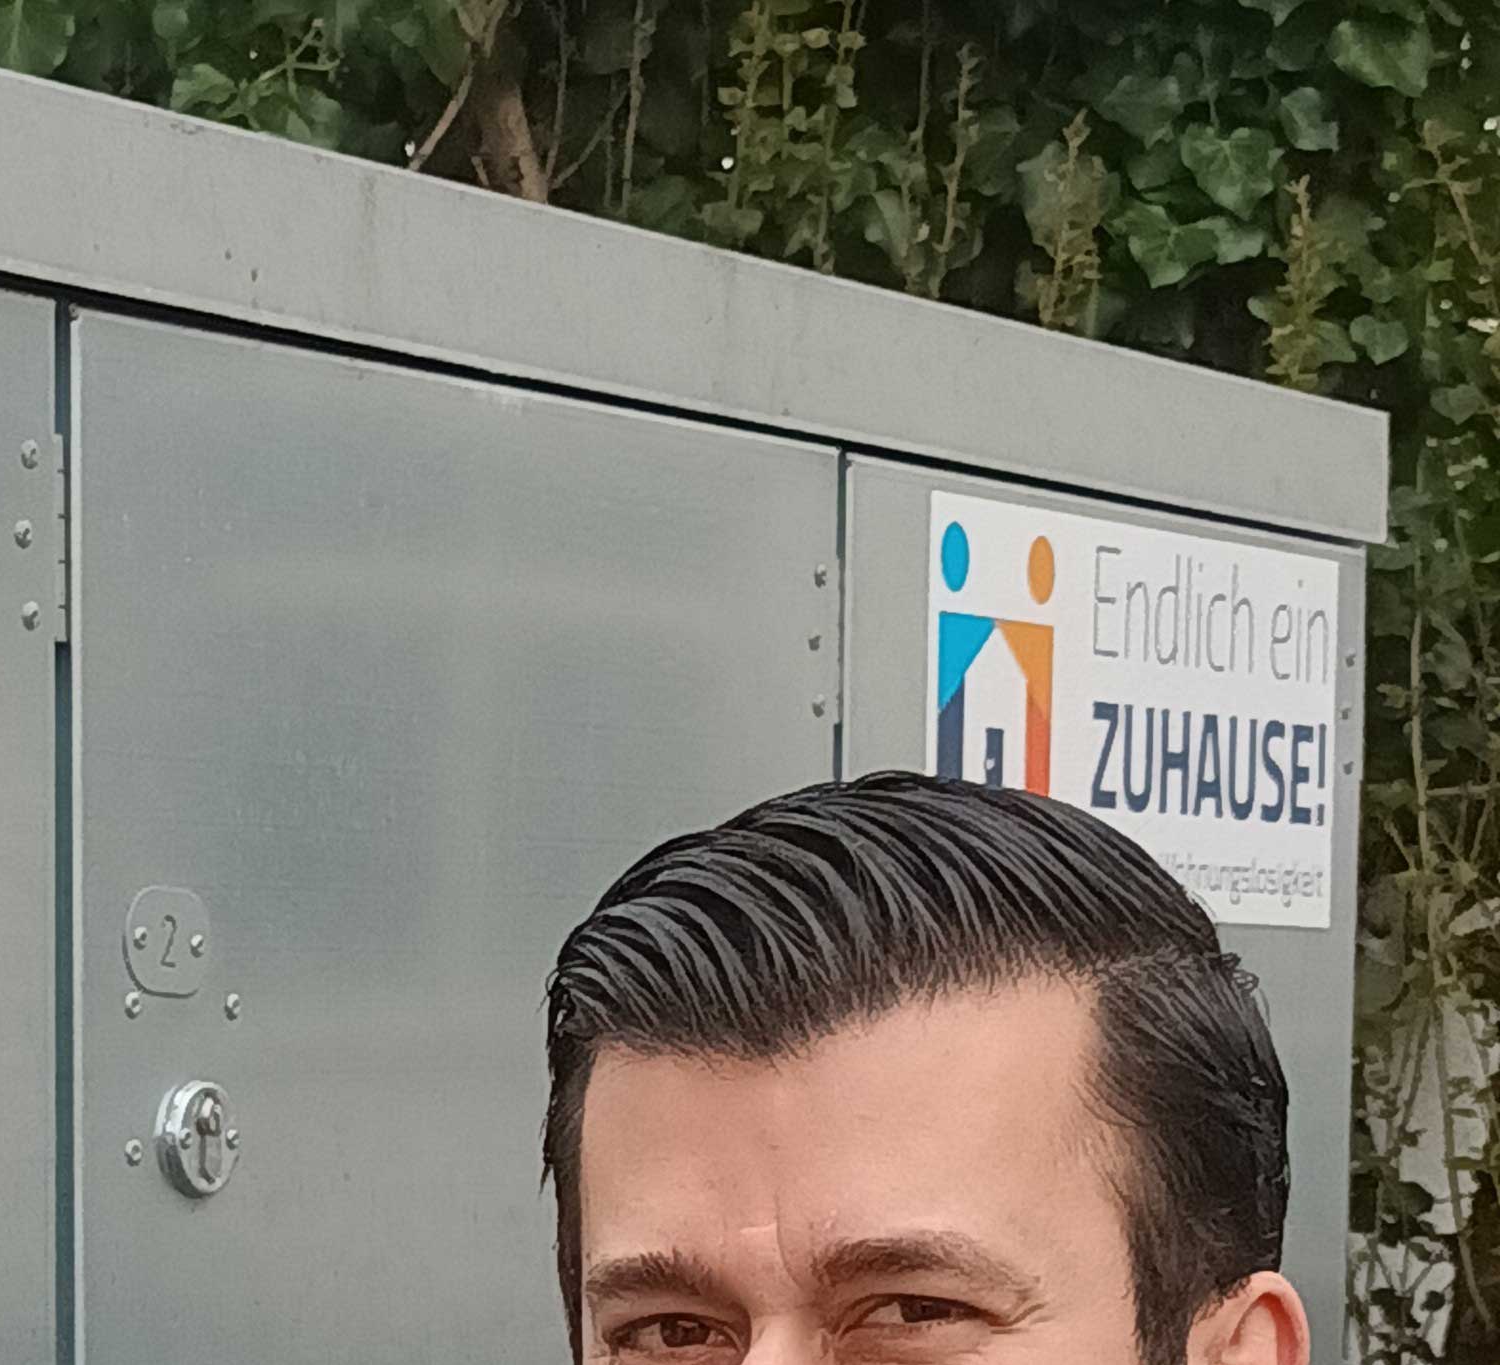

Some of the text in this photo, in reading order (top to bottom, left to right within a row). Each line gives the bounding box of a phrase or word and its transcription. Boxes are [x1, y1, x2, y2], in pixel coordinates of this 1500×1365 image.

[1092, 544, 1329, 684] Endlich ein
[1089, 700, 1328, 827] ZUHAUSE!
[160, 914, 177, 968] 2
